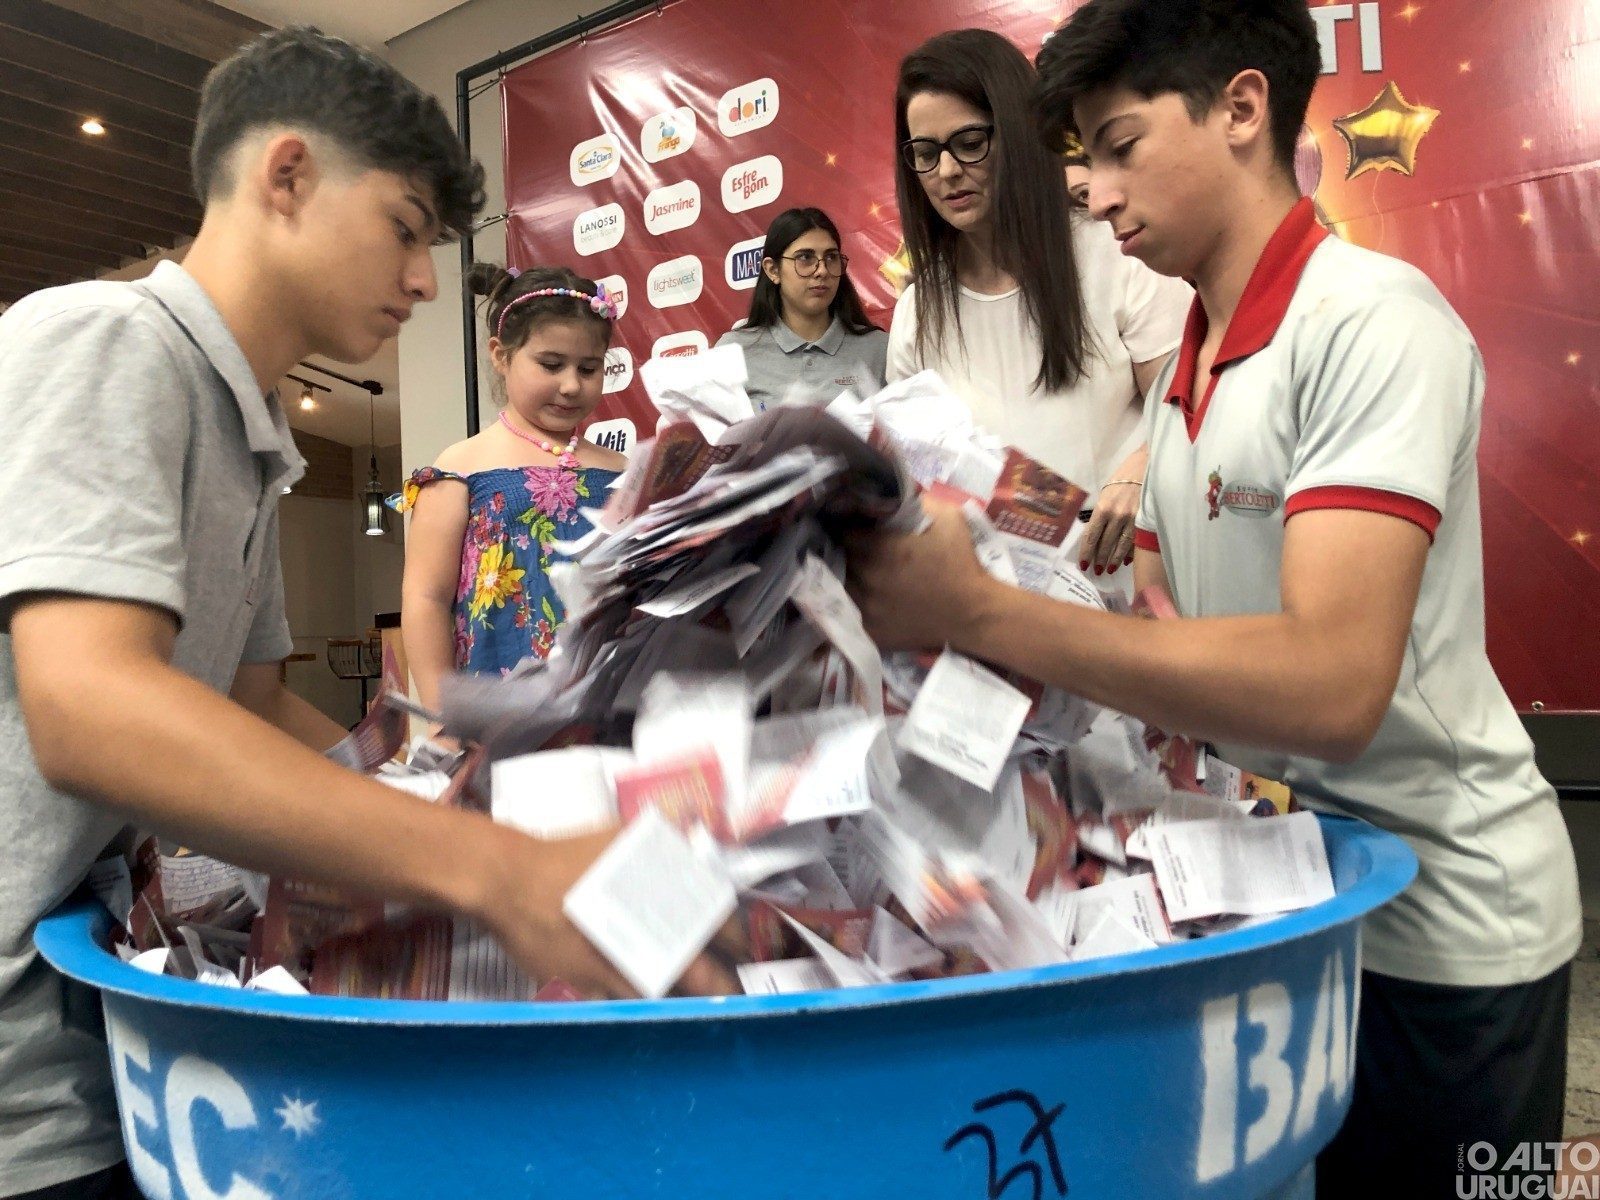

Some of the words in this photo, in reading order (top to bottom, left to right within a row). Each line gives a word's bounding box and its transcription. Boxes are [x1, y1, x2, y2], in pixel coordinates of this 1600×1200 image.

[728, 89, 768, 122] dori
[580, 157, 597, 169] Santa
[597, 153, 612, 164] Clara
[731, 170, 757, 192] Esfre
[743, 176, 768, 200] Bom
[650, 197, 695, 221] Jasmine
[580, 215, 617, 234] LANOSSI
[736, 249, 764, 279] MAG
[595, 429, 627, 453] Mili
